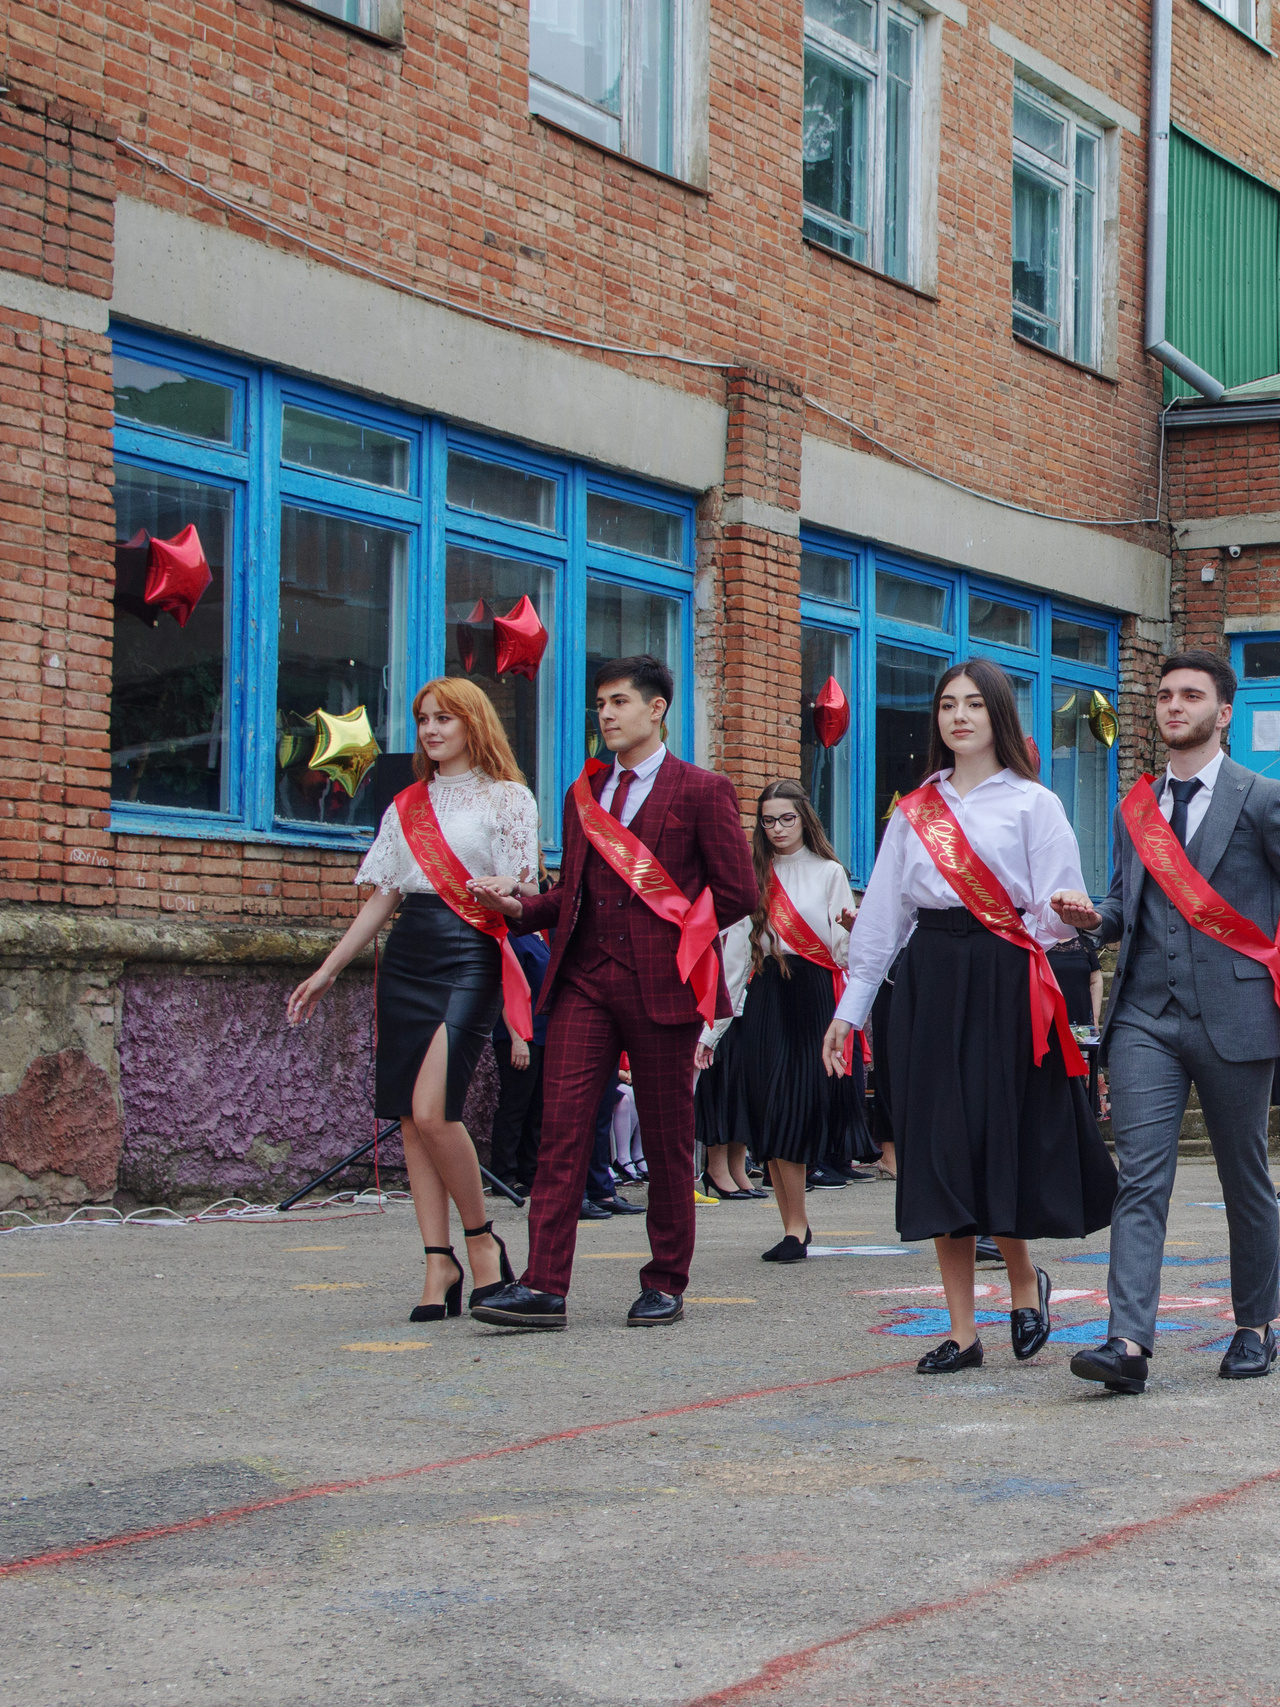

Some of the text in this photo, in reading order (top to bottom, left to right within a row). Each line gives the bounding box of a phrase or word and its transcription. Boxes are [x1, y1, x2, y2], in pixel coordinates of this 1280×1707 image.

[412, 821, 468, 903] Выпускник
[621, 859, 671, 894] 2021
[926, 819, 999, 908] Выпускник
[1142, 823, 1207, 910] Выпускник
